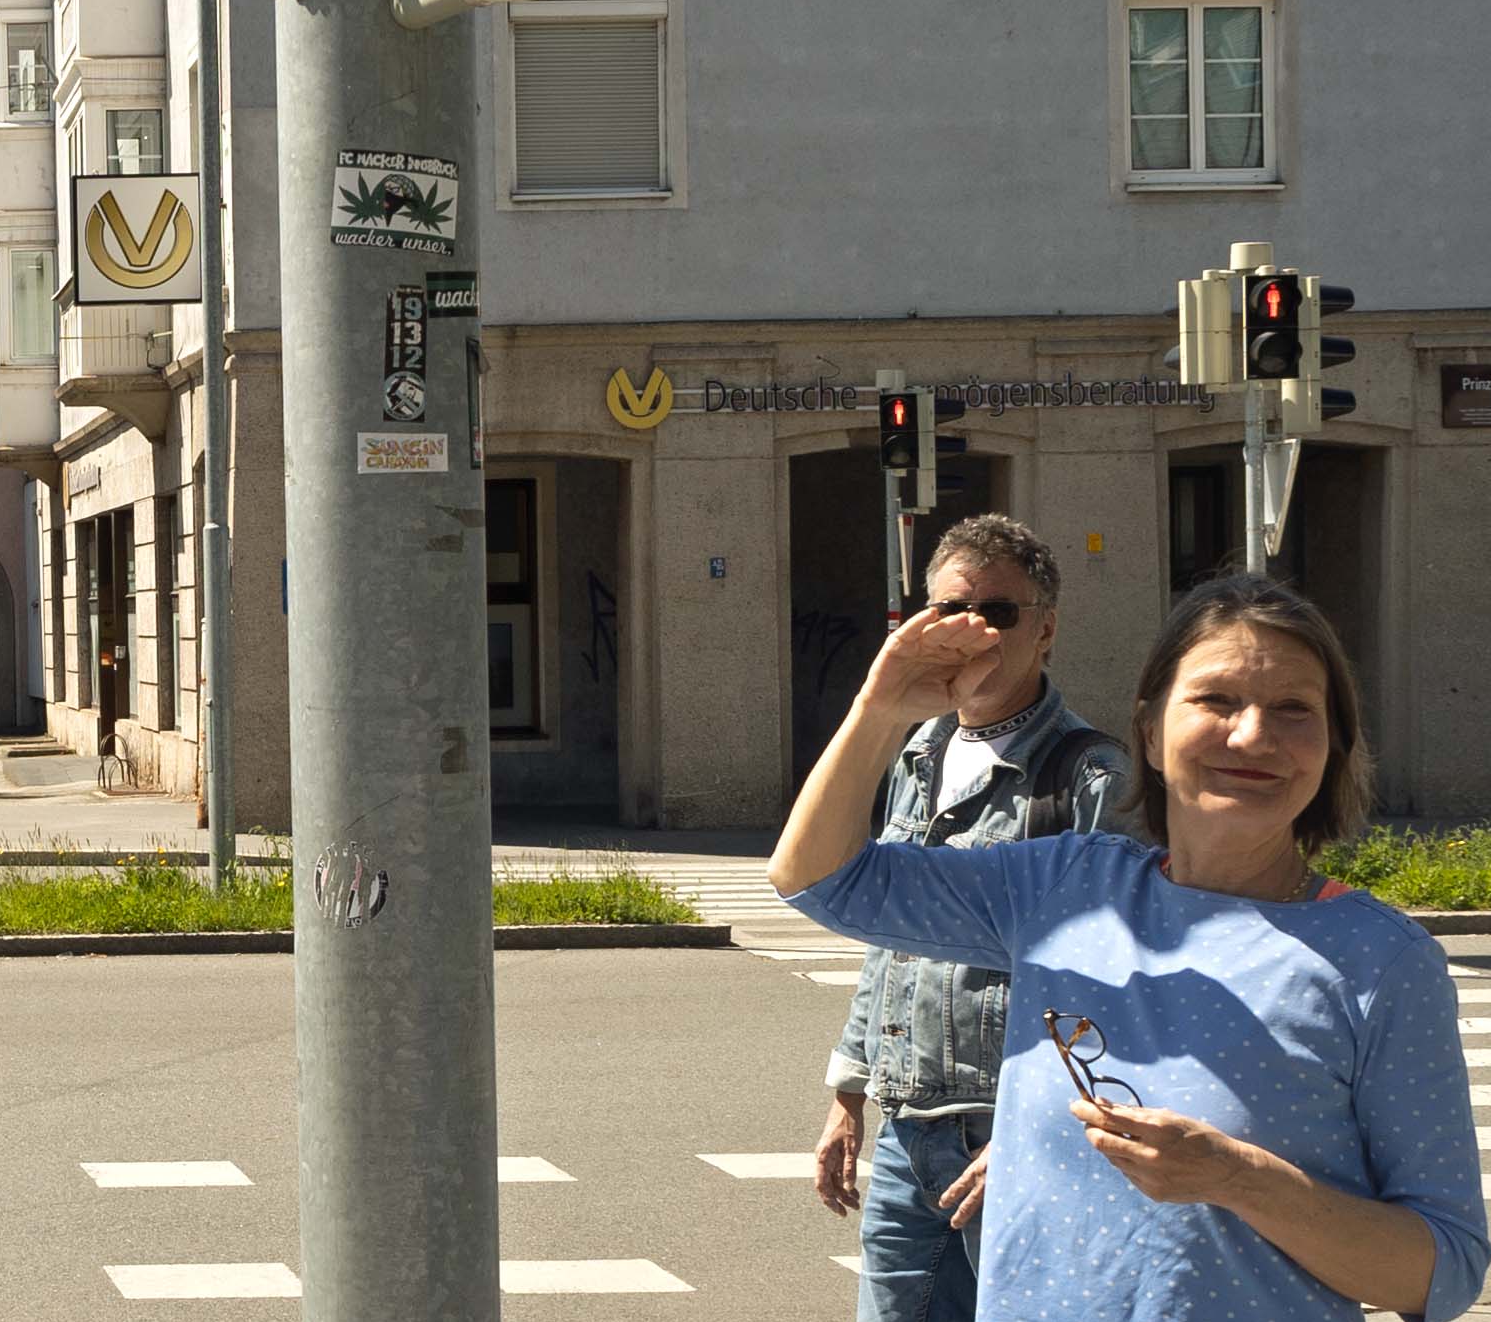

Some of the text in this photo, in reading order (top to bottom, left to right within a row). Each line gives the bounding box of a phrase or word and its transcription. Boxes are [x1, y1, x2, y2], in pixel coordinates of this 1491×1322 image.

[339, 152, 354, 165] FC
[335, 230, 452, 256] wacker unser.
[434, 280, 480, 308] wack
[392, 296, 423, 321] 19
[390, 321, 423, 345] 13
[390, 345, 424, 369] 12
[704, 377, 858, 413] Deutsche
[909, 372, 1216, 417] mögensberatung
